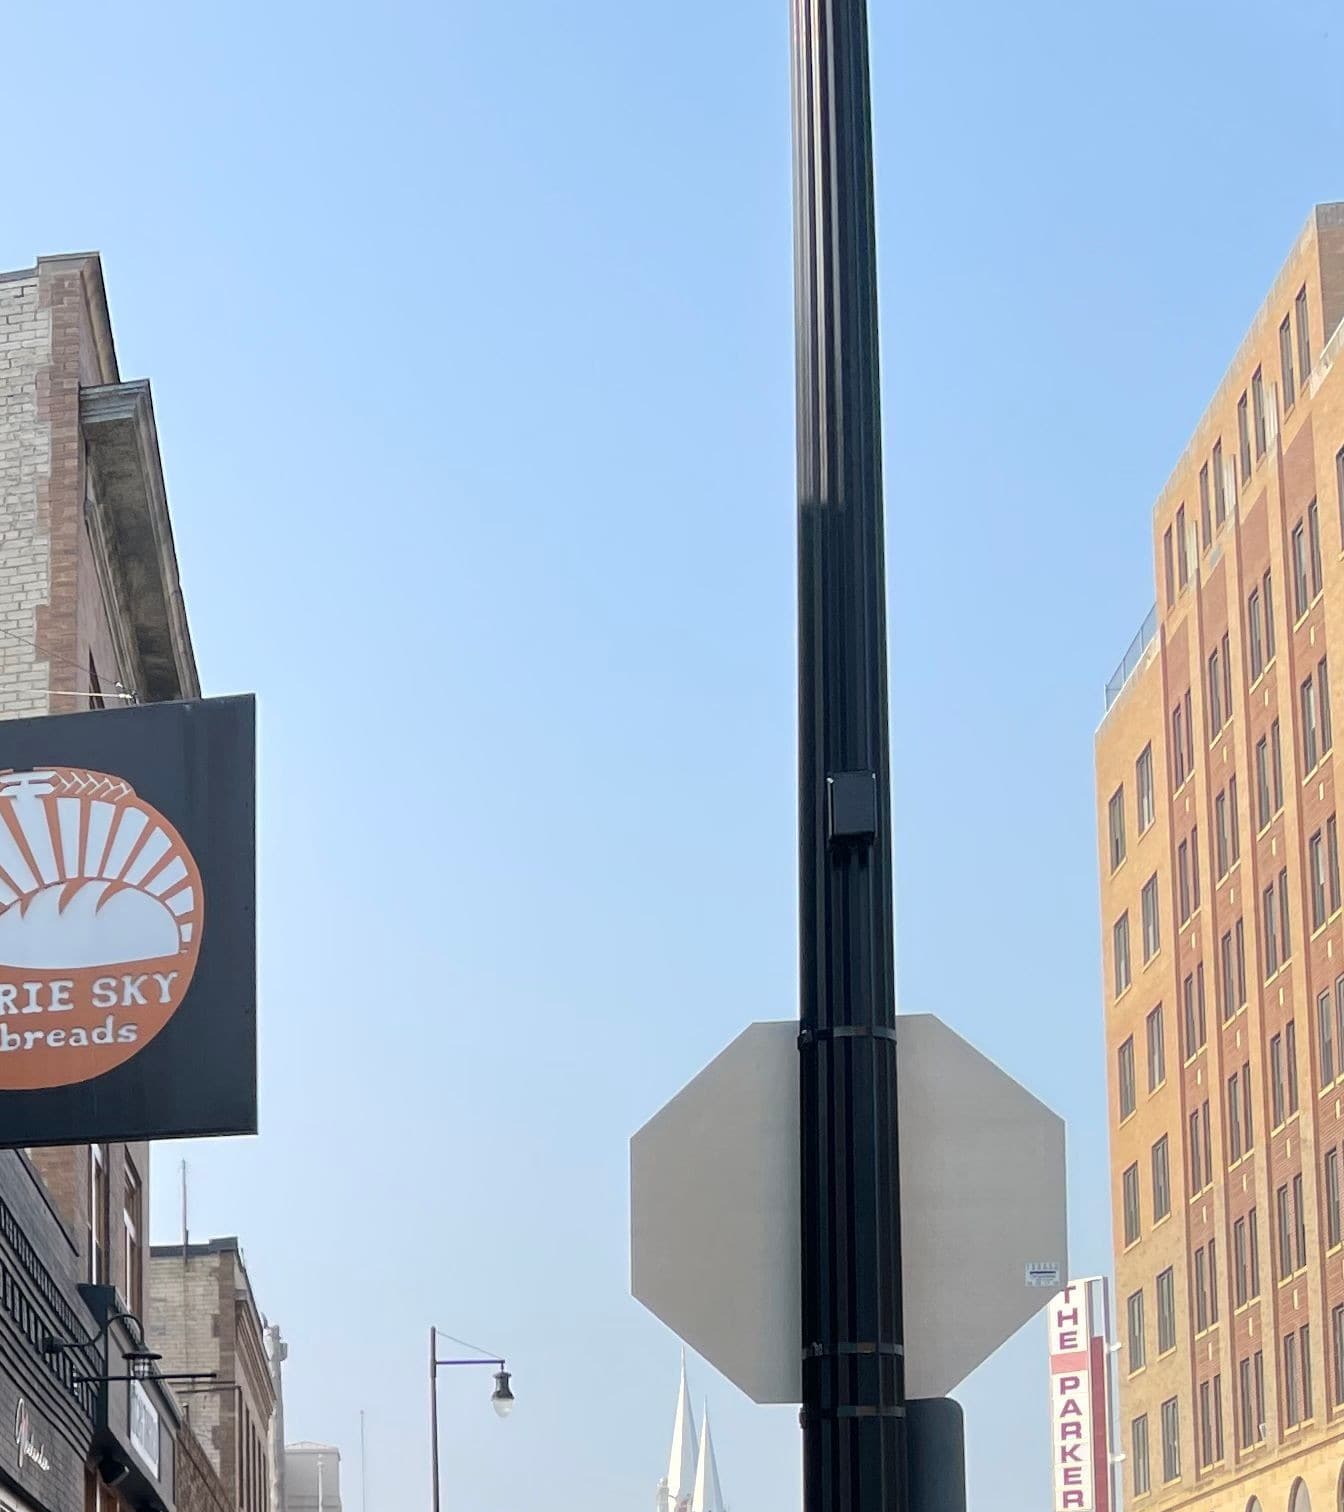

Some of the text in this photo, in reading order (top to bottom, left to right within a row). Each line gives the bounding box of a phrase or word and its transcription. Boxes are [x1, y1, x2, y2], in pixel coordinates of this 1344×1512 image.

[91, 971, 179, 1009] SKY
[1057, 1285, 1084, 1509] THE PARKER
